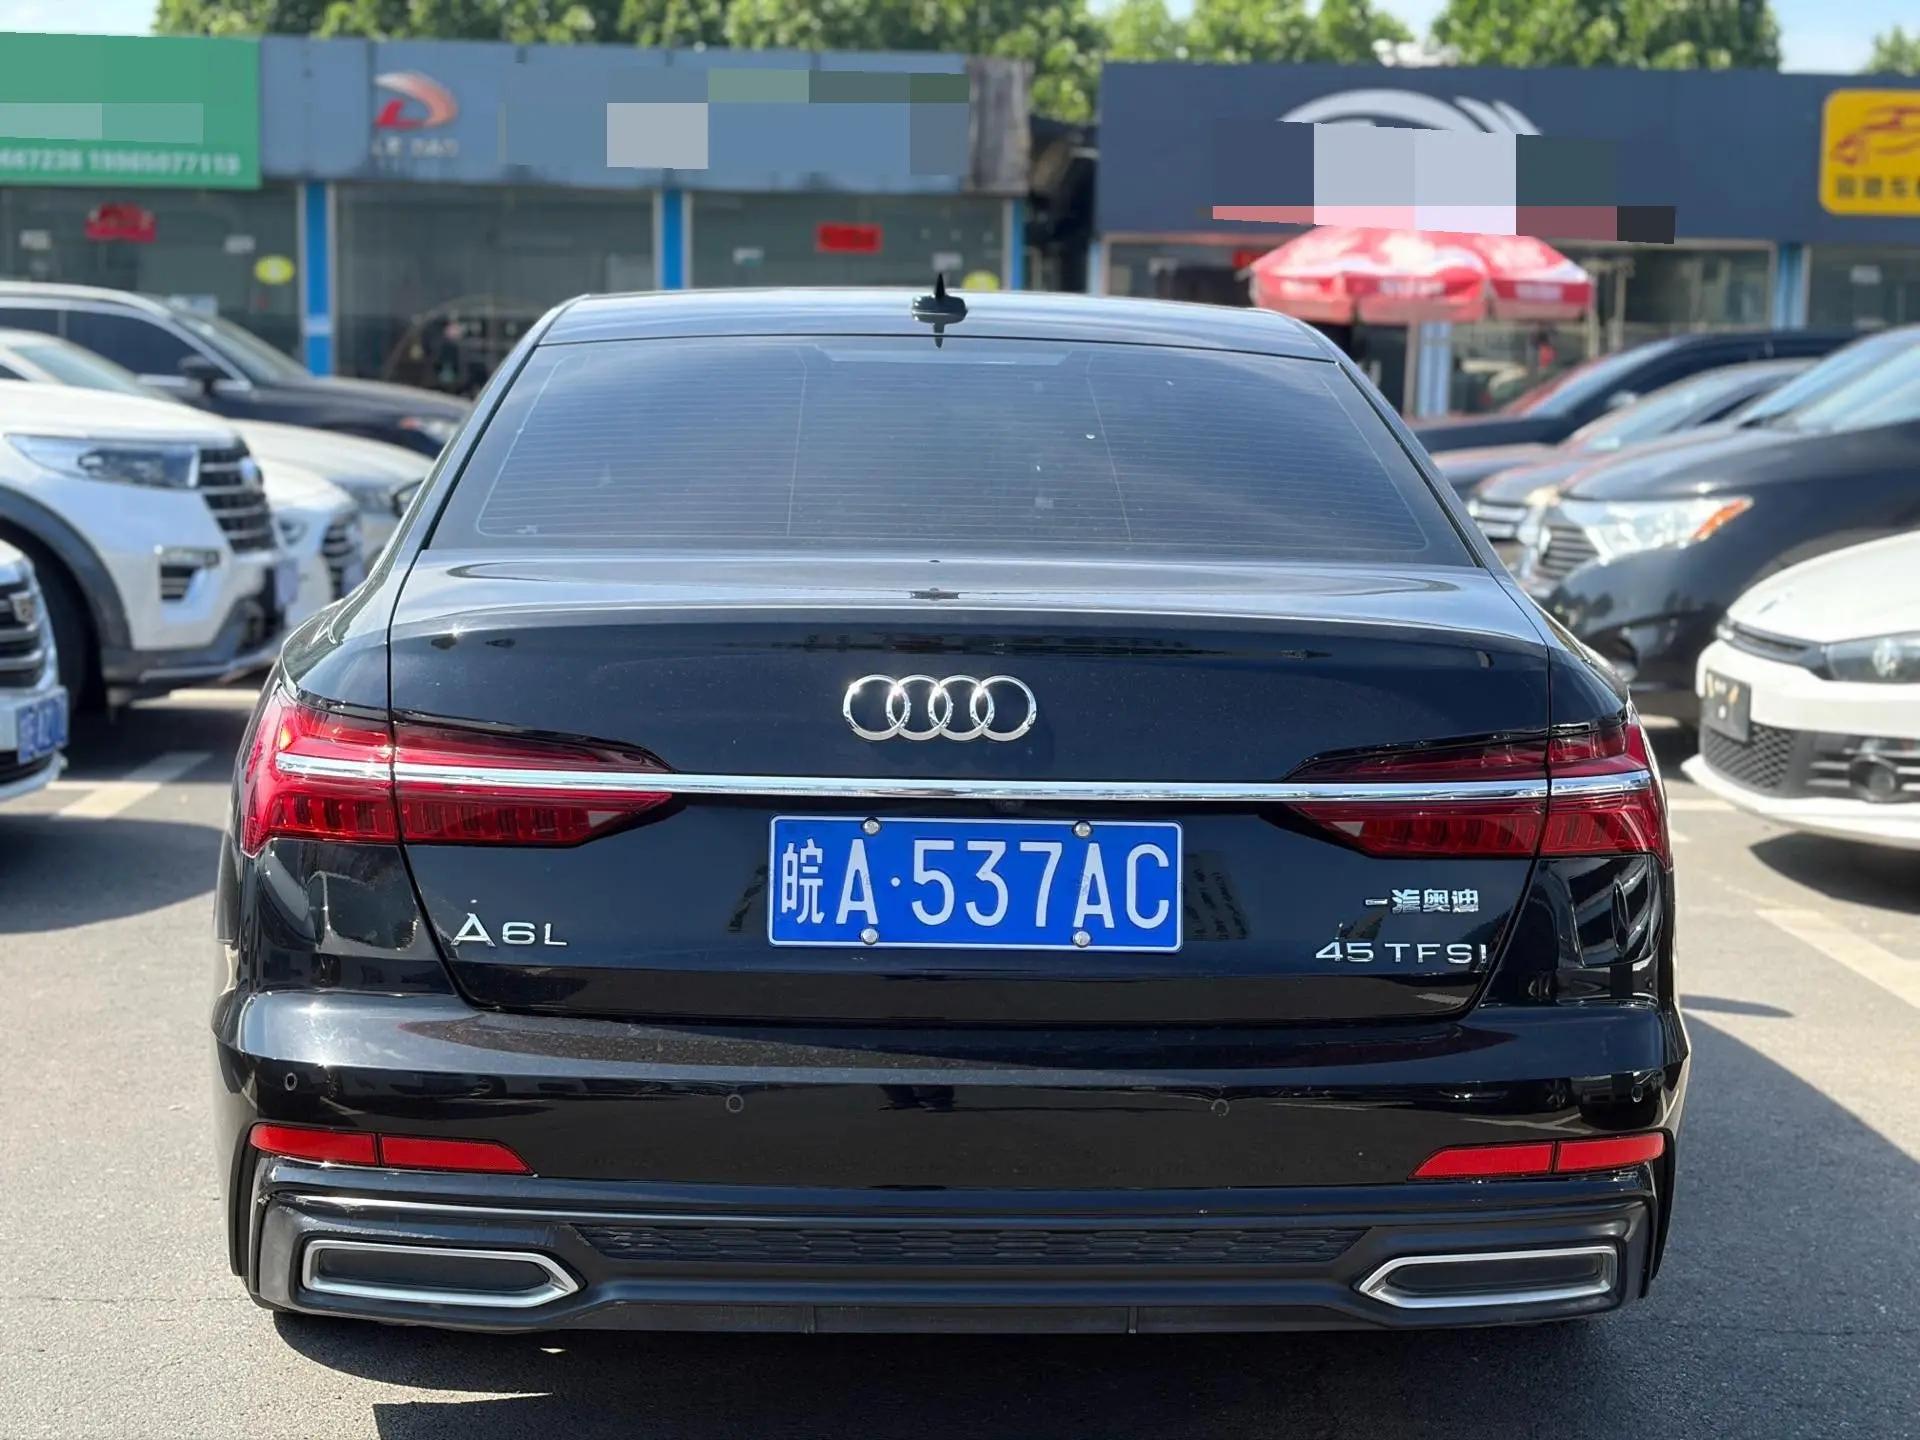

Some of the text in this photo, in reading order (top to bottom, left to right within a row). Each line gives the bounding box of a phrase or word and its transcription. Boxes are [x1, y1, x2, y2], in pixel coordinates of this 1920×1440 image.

[781, 838, 1169, 929] 皖A·537AC
[1365, 888, 1479, 913] 一汽奥迪
[450, 912, 567, 947] A6L
[1315, 941, 1487, 964] 45 TFSI
